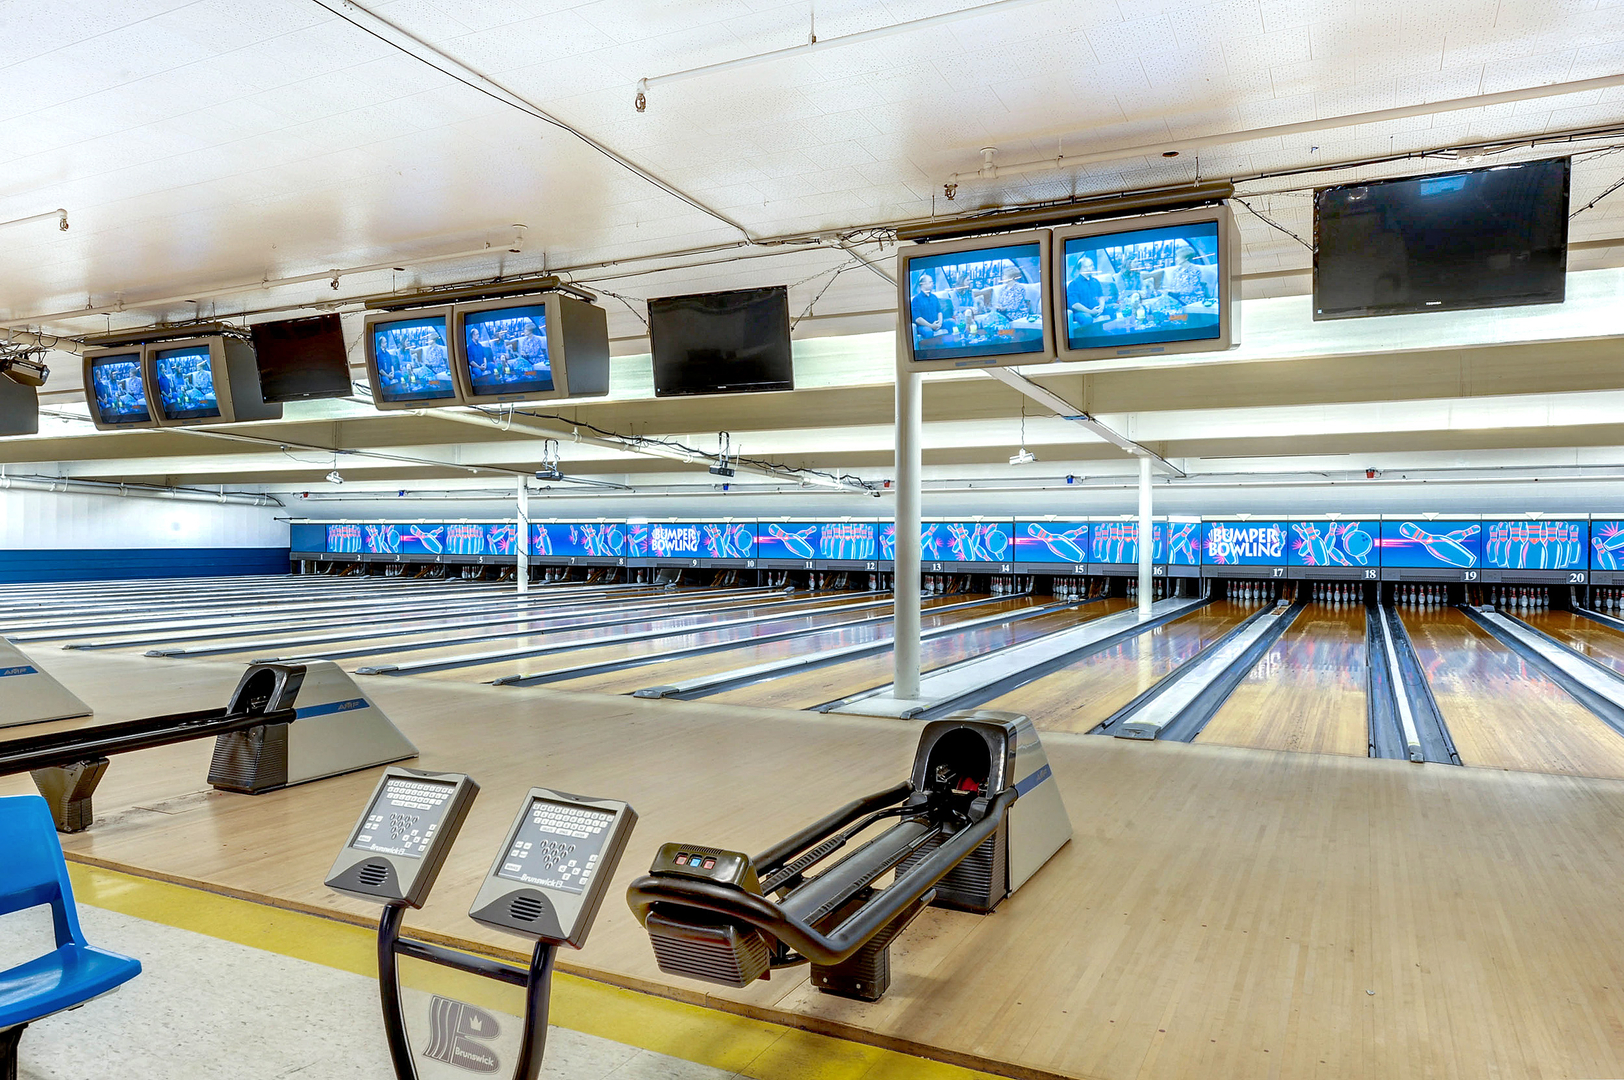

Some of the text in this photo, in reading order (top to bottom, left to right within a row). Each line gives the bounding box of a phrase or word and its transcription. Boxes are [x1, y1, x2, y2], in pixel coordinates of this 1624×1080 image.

[653, 528, 696, 541] BUMPER
[1213, 528, 1277, 543] BUMPER
[651, 539, 698, 552] BOWLING
[1208, 542, 1282, 557] BOWLING
[692, 559, 697, 567] 9
[747, 560, 755, 568] 10
[805, 561, 813, 569] 11
[866, 562, 875, 570] 12
[932, 563, 942, 571] 13
[1001, 564, 1010, 572] 14
[1074, 565, 1084, 574] 15
[1152, 566, 1163, 575] 16
[1272, 568, 1284, 577] 17
[1364, 569, 1376, 579] 18
[1464, 571, 1477, 581] 19
[1569, 572, 1585, 583] 20
[4, 667, 27, 675] AMF
[338, 701, 360, 710] AMF
[370, 843, 400, 855] Brunswick
[521, 873, 556, 888] Brunswick
[455, 1046, 494, 1066] Brunswick
